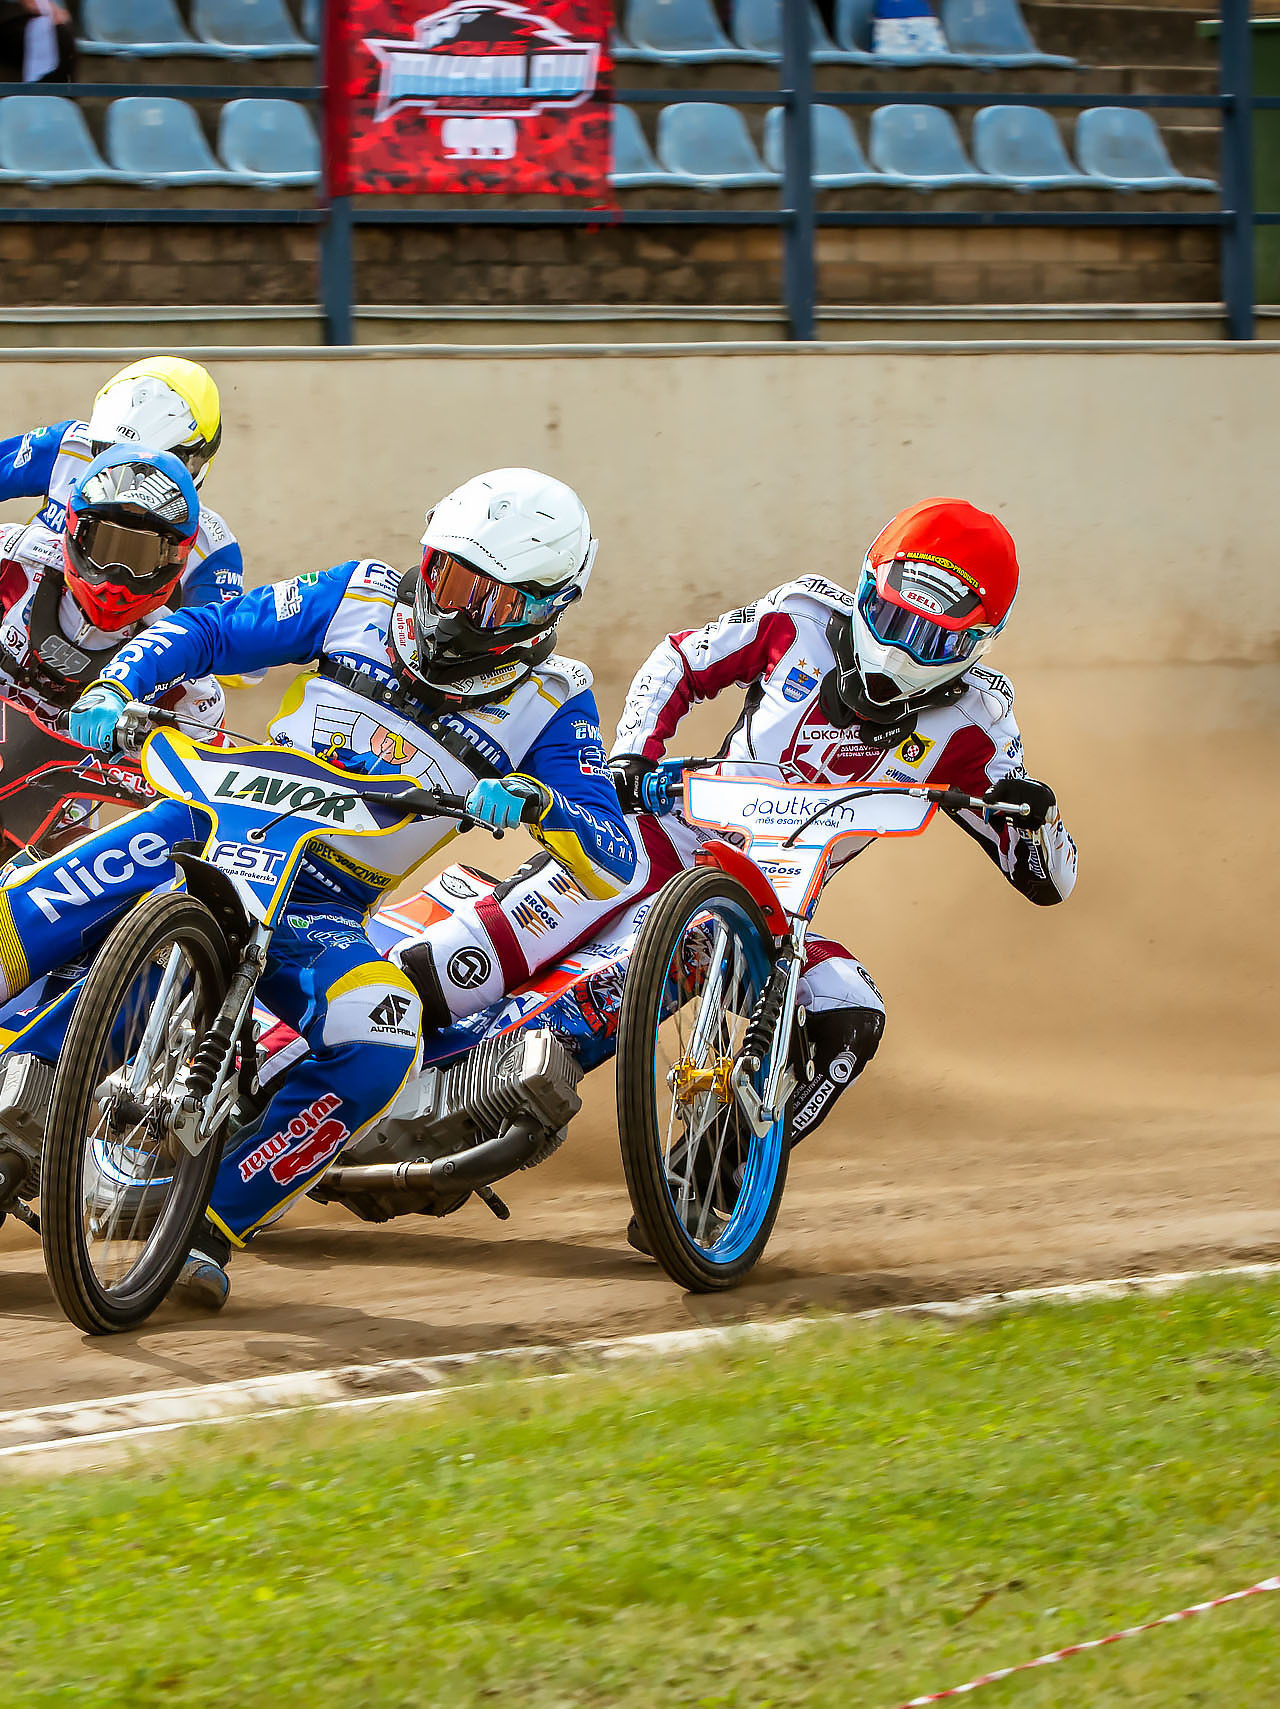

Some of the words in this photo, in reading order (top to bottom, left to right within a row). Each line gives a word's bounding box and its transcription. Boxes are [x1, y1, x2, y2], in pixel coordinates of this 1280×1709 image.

[906, 592, 937, 611] BELL
[213, 771, 357, 825] LAVOR
[777, 817, 802, 825] esam
[211, 843, 284, 872] FST
[761, 866, 803, 876] RGOSS
[25, 831, 171, 925] Nice
[239, 870, 275, 883] Brokerska
[522, 892, 559, 931] ERGOSS
[370, 1026, 397, 1034] AUTO
[794, 1082, 833, 1129] NORTH
[239, 1092, 344, 1183] auto-mar
